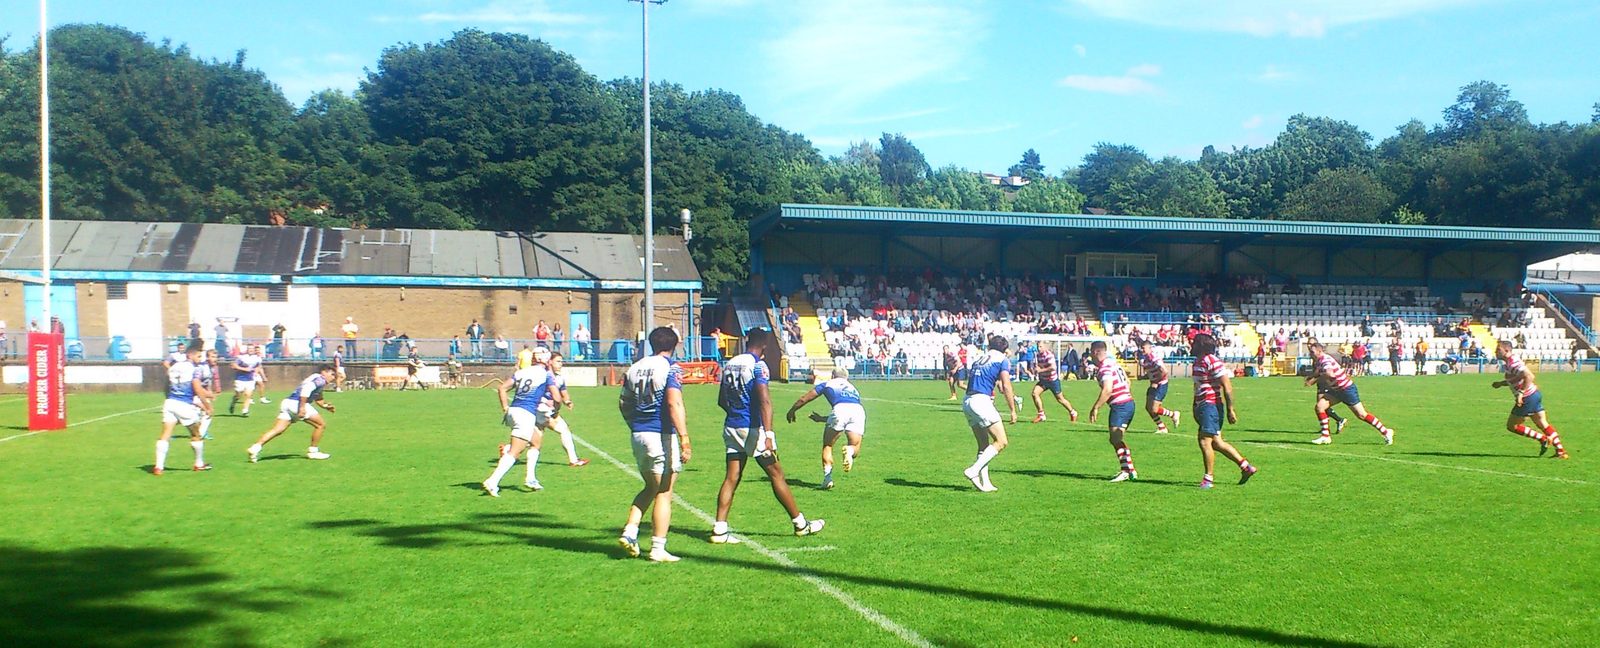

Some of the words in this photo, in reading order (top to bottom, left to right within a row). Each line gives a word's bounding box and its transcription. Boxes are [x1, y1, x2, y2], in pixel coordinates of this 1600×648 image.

[37, 350, 48, 377] CIDER
[37, 379, 48, 415] PROPER
[516, 378, 532, 395] 18
